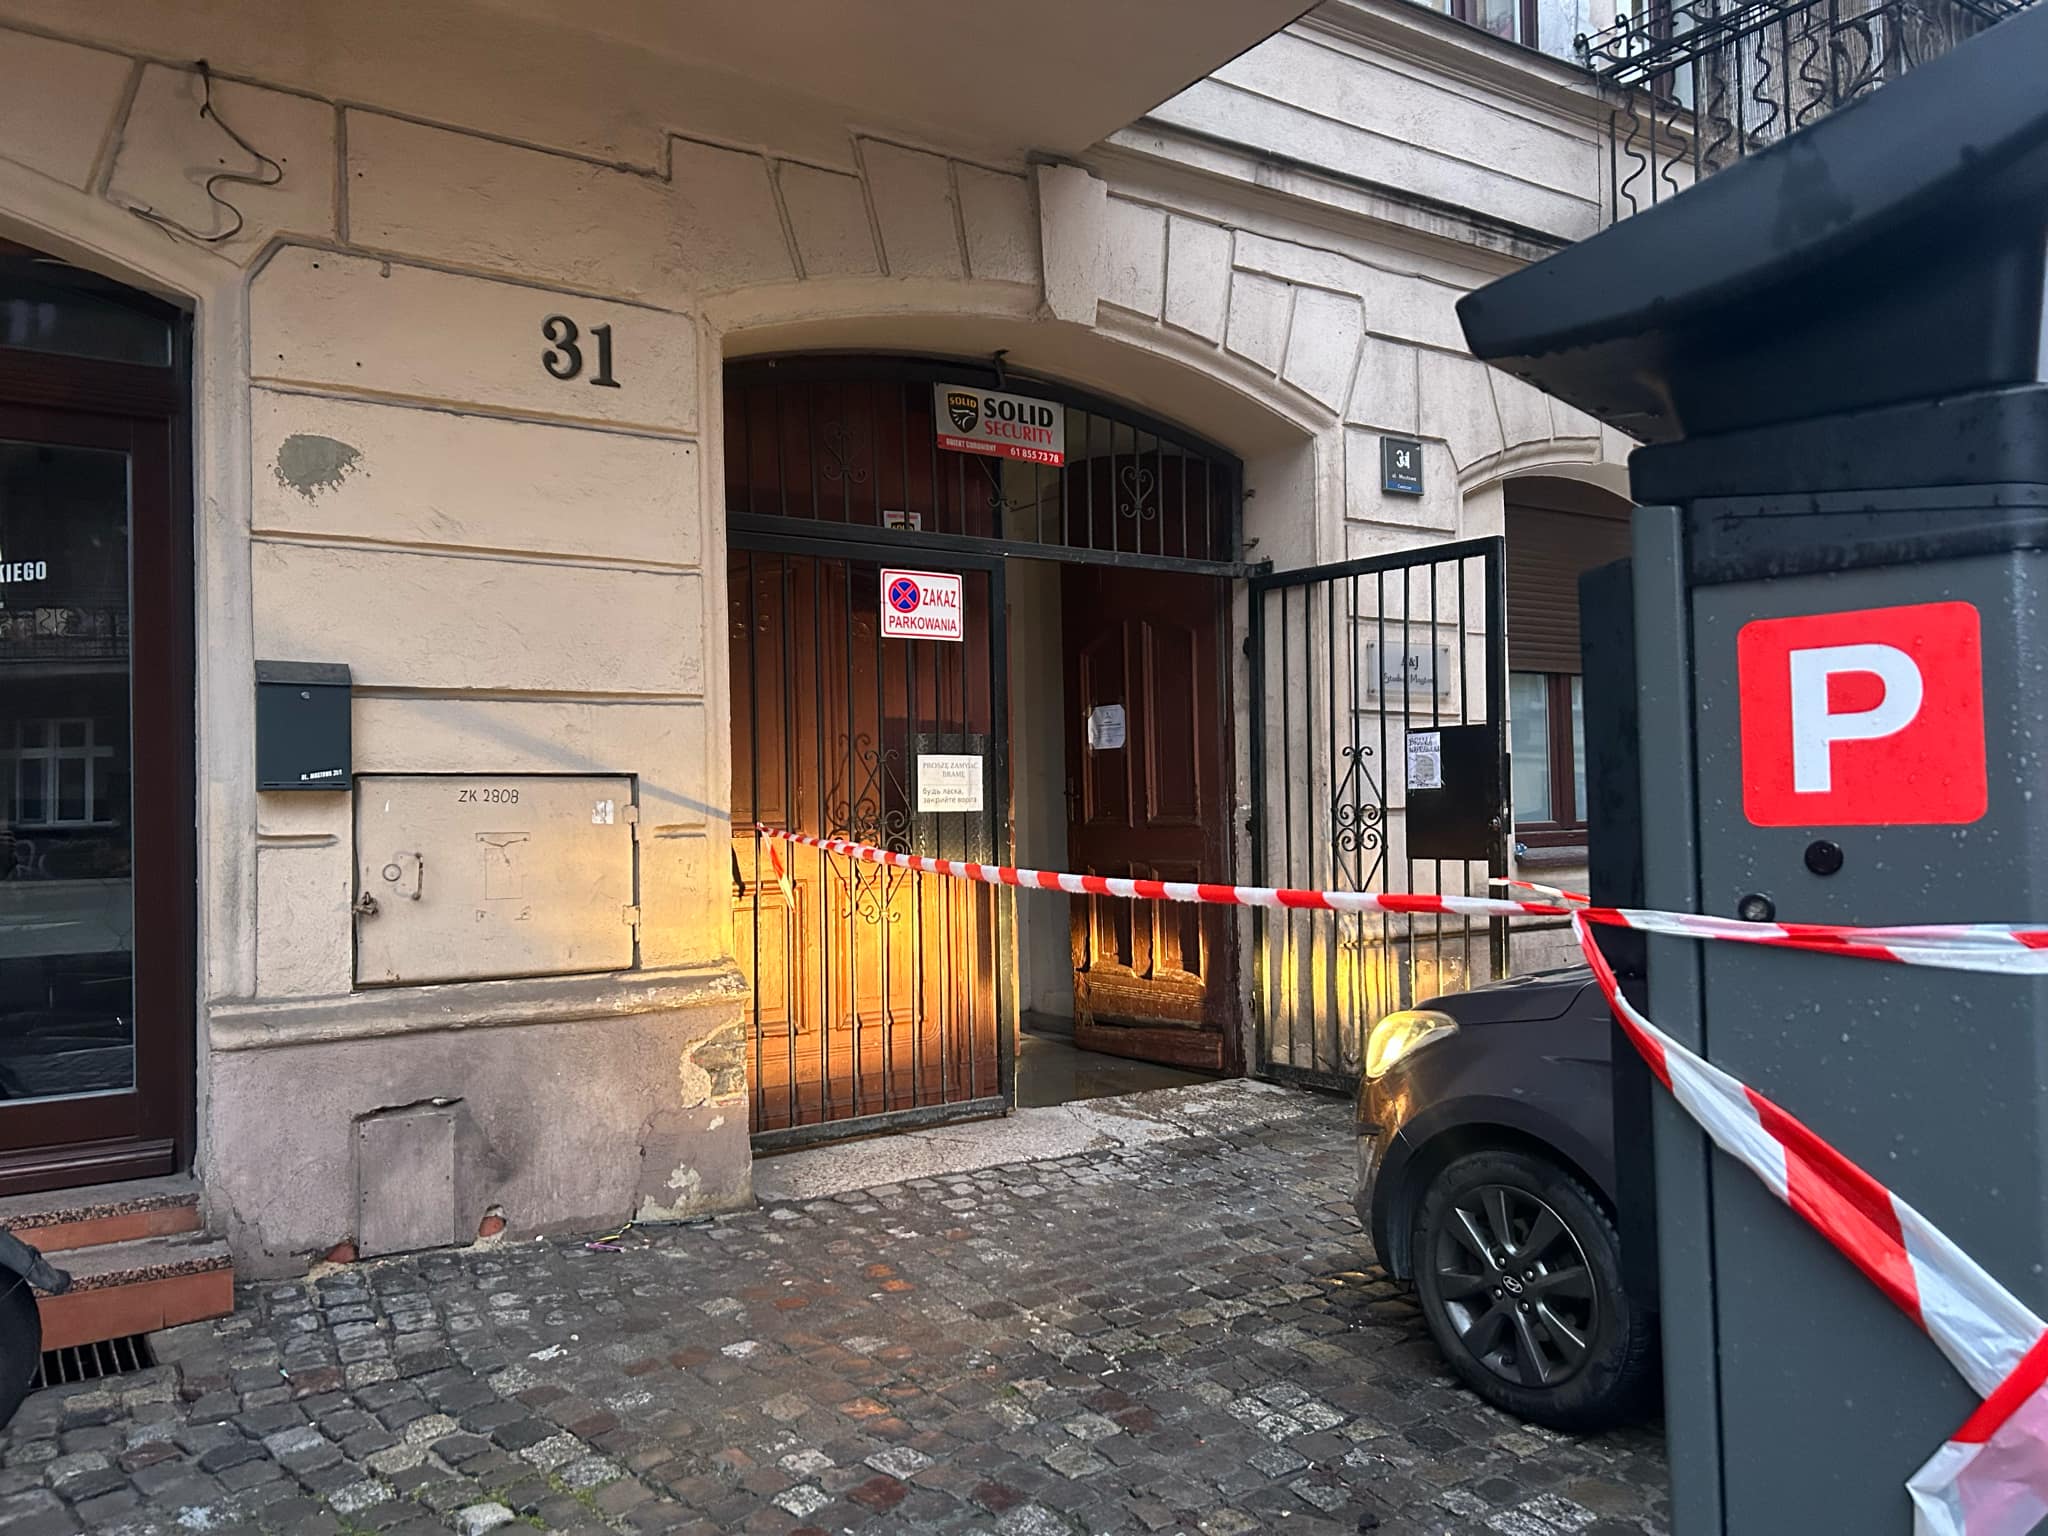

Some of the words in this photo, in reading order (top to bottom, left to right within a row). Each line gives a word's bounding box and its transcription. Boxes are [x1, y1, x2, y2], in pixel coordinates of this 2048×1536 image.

[543, 315, 621, 388] 31
[949, 396, 977, 408] SOLID
[984, 398, 1054, 427] SOLID
[984, 420, 1053, 445] SECURITY
[1010, 447, 1020, 457] 61
[1022, 449, 1037, 459] 855
[1037, 451, 1048, 461] 73
[1049, 453, 1059, 463] 78
[923, 588, 957, 608] ZAKAZ
[888, 615, 958, 632] PARKOWANIA
[1790, 643, 1923, 793] P
[458, 790, 478, 803] ZK
[483, 789, 519, 803] 2808
